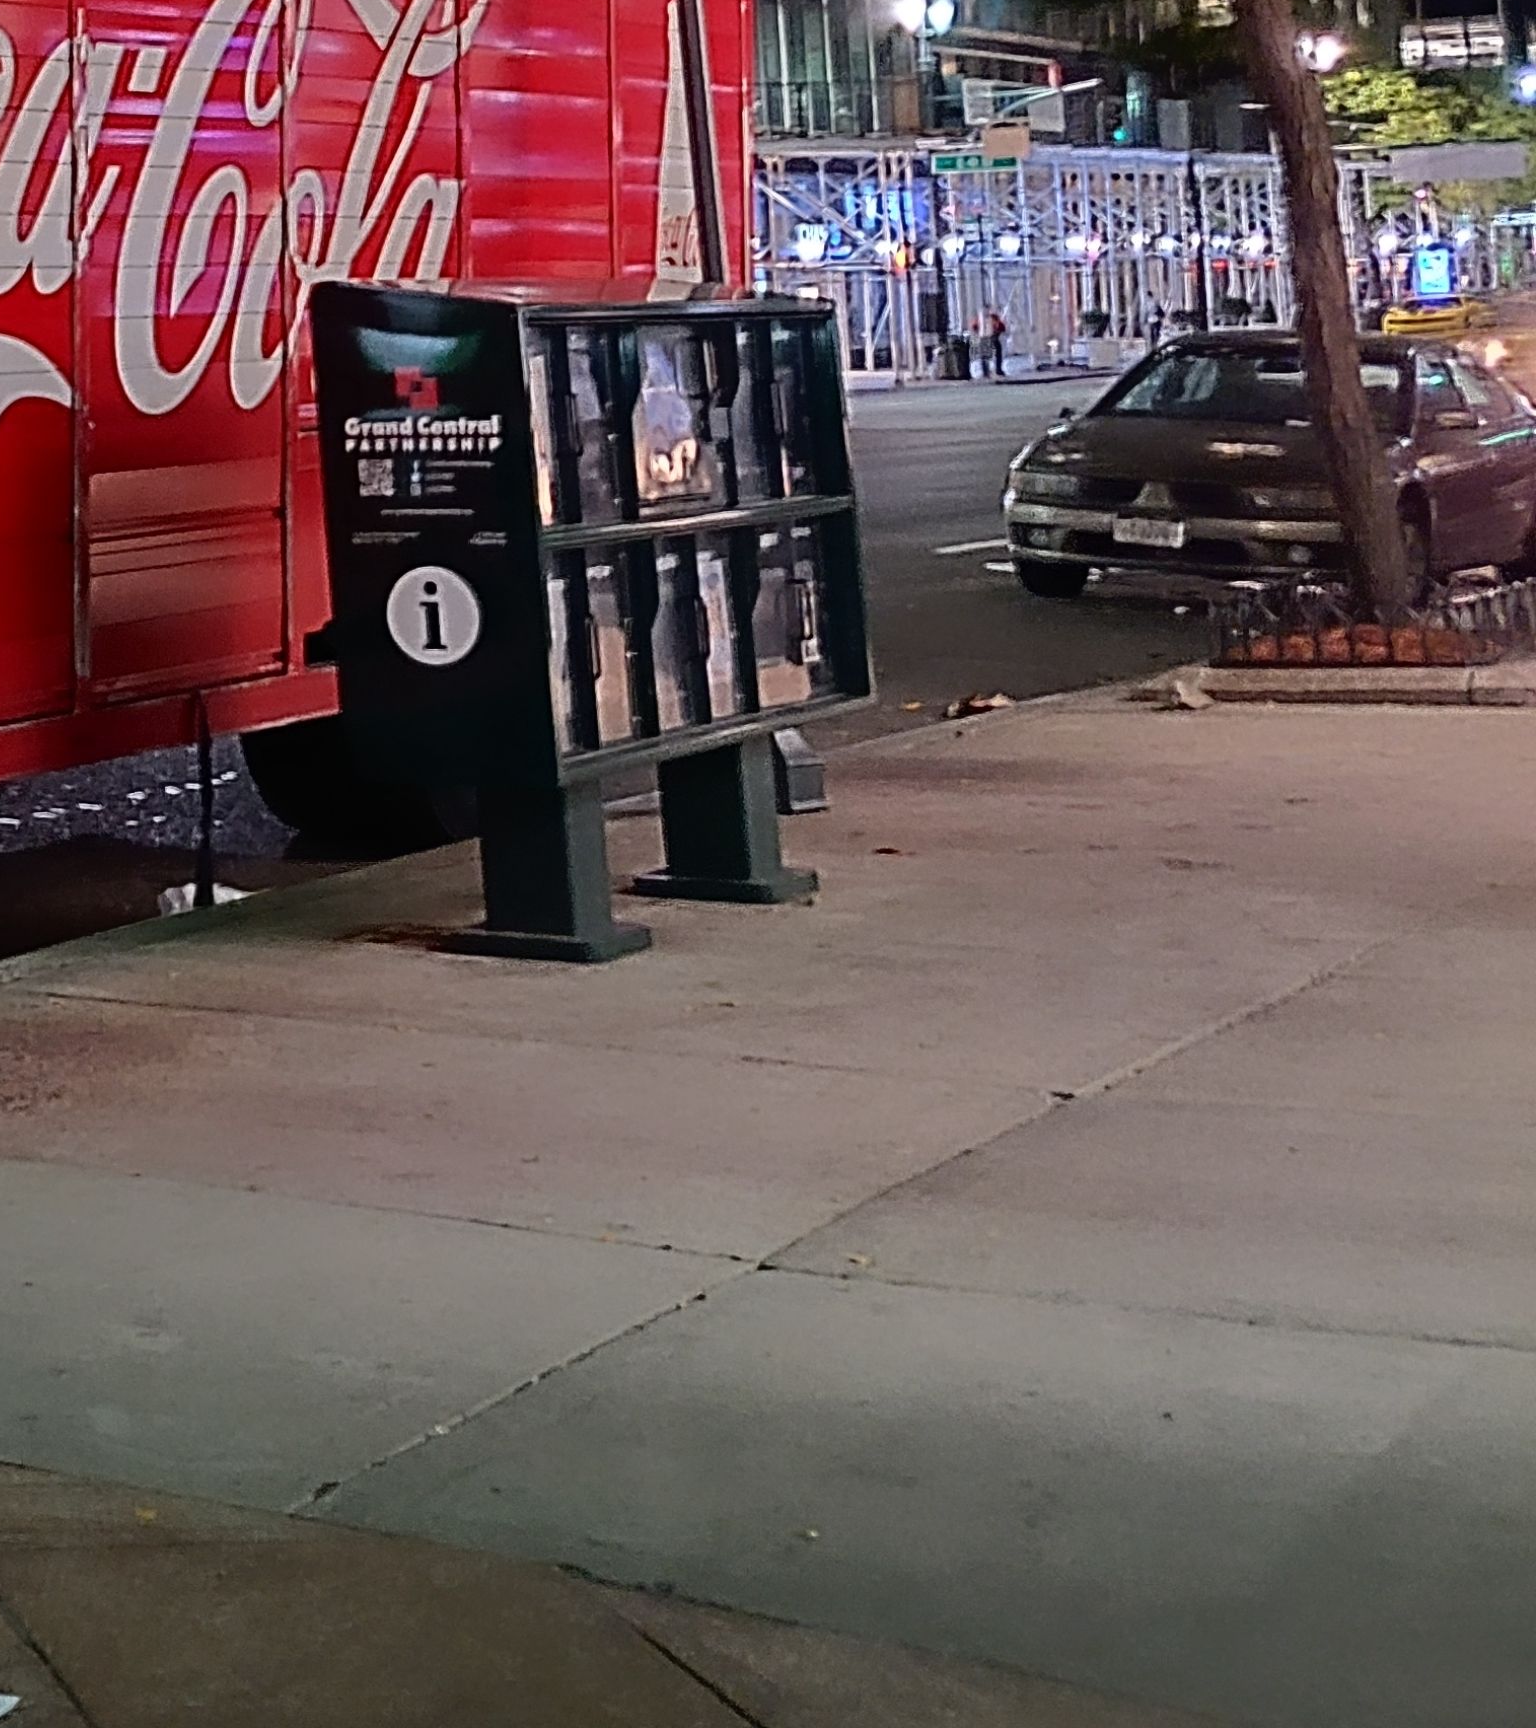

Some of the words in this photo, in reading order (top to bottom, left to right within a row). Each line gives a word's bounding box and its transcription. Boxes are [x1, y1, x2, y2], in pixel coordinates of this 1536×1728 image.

[344, 416, 413, 436] Grand
[416, 414, 503, 436] Central
[345, 437, 503, 453] PARTNERSHIP
